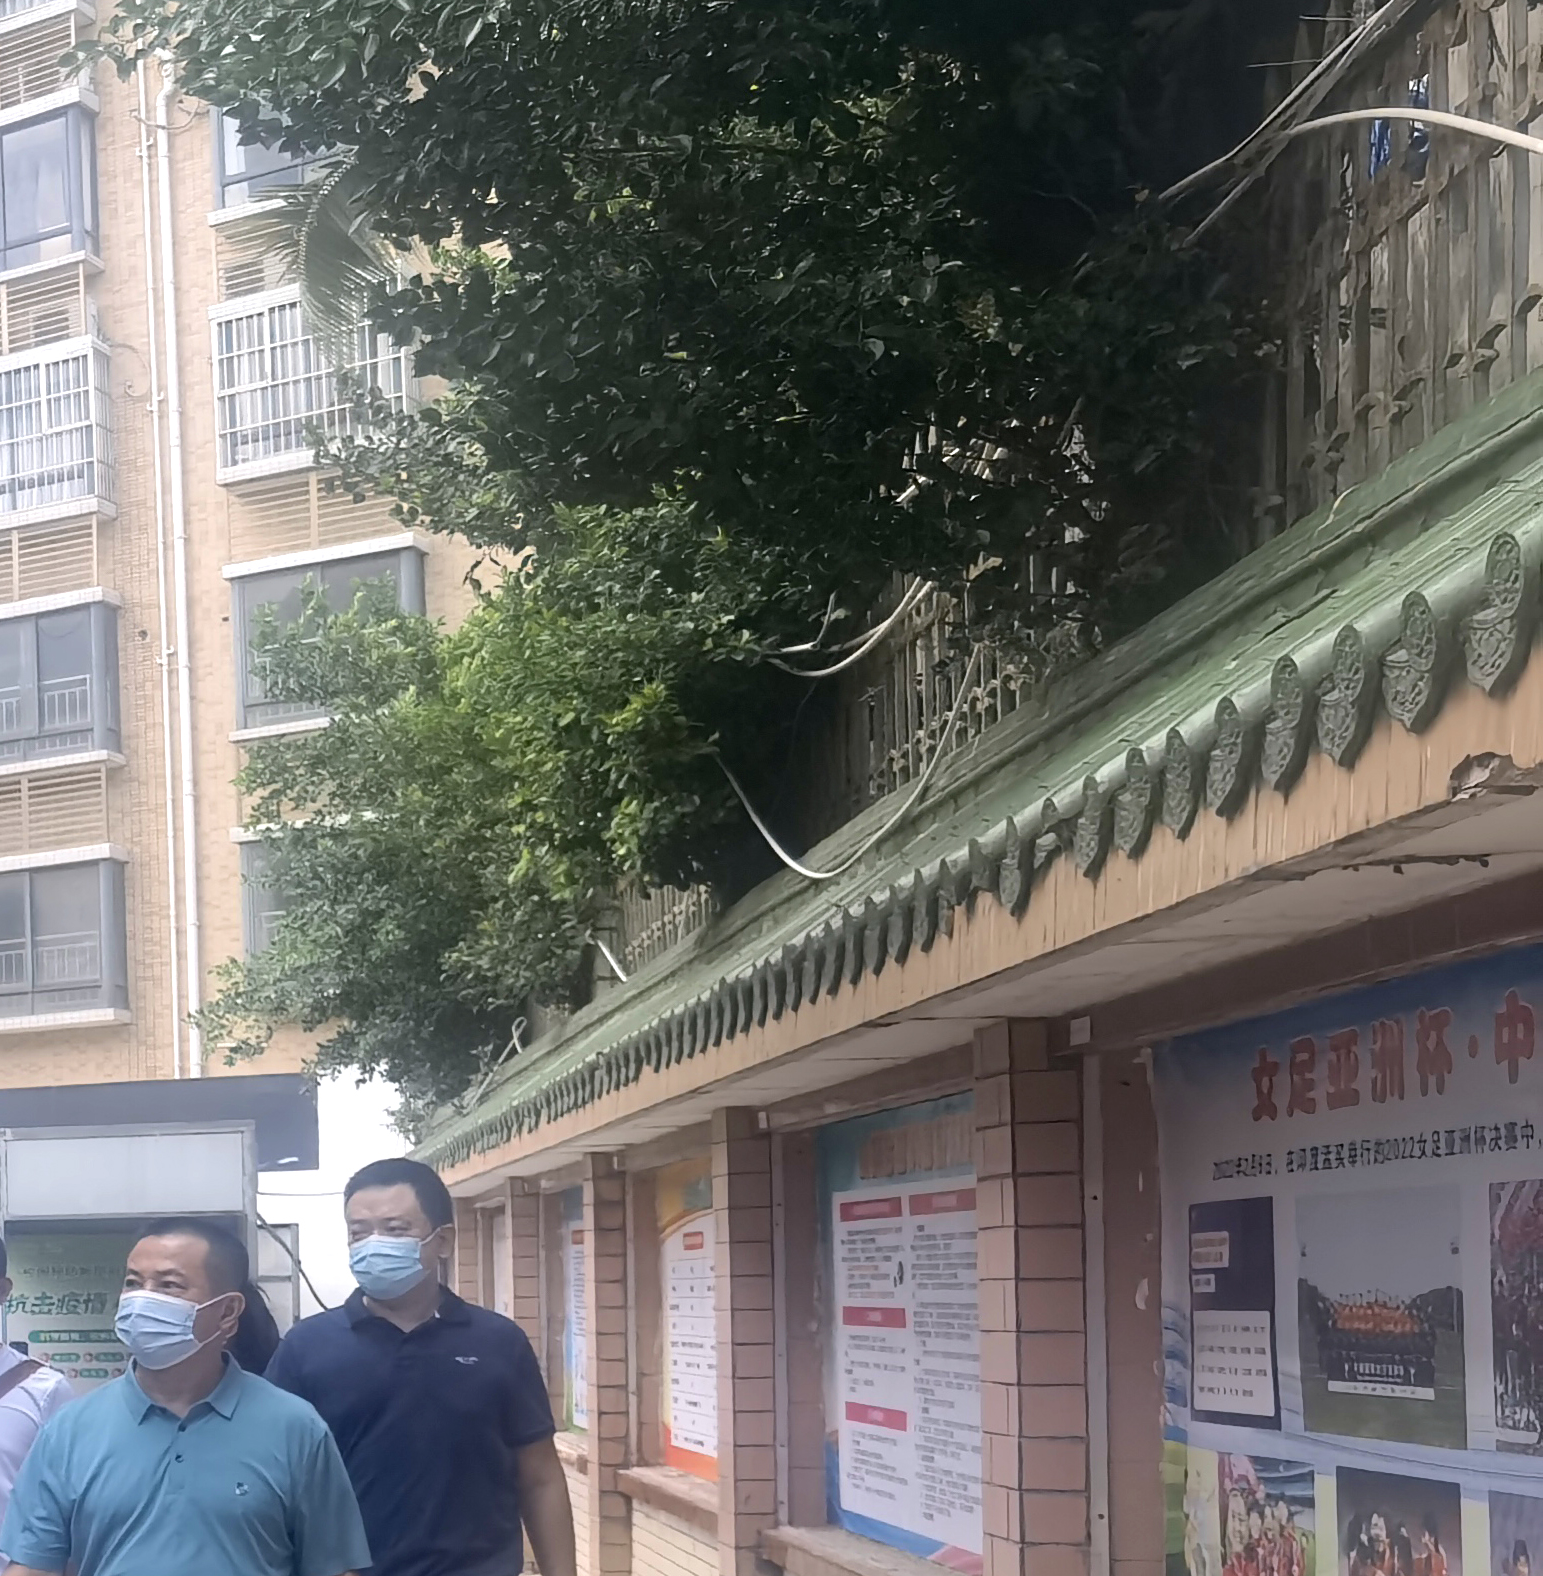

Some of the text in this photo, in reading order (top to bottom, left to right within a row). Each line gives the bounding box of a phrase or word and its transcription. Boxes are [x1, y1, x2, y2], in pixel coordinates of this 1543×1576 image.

[1251, 988, 1534, 1122] 女足亚洲杯·中
